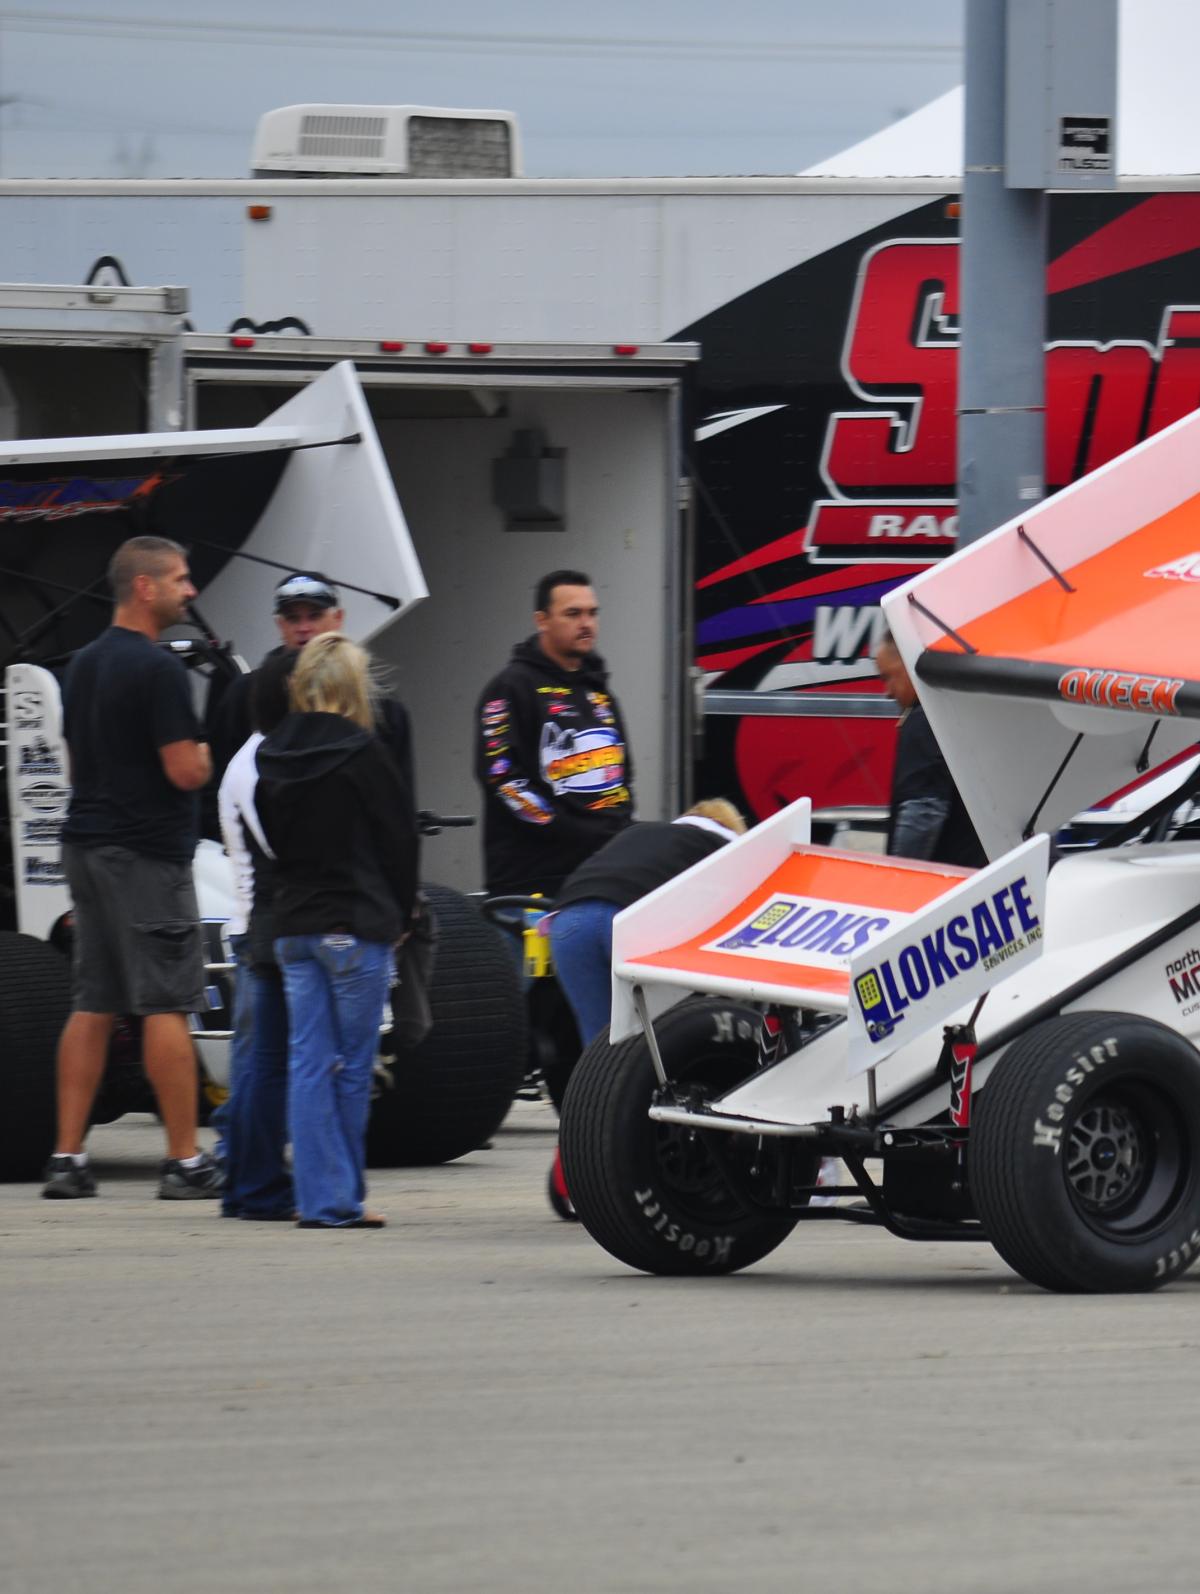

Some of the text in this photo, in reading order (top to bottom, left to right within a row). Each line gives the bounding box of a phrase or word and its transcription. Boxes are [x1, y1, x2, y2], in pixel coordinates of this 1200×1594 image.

[1057, 667, 1185, 715] QUEEN
[879, 875, 1040, 1014] LOKSAFE
[1033, 1037, 1119, 1156] Hoosier
